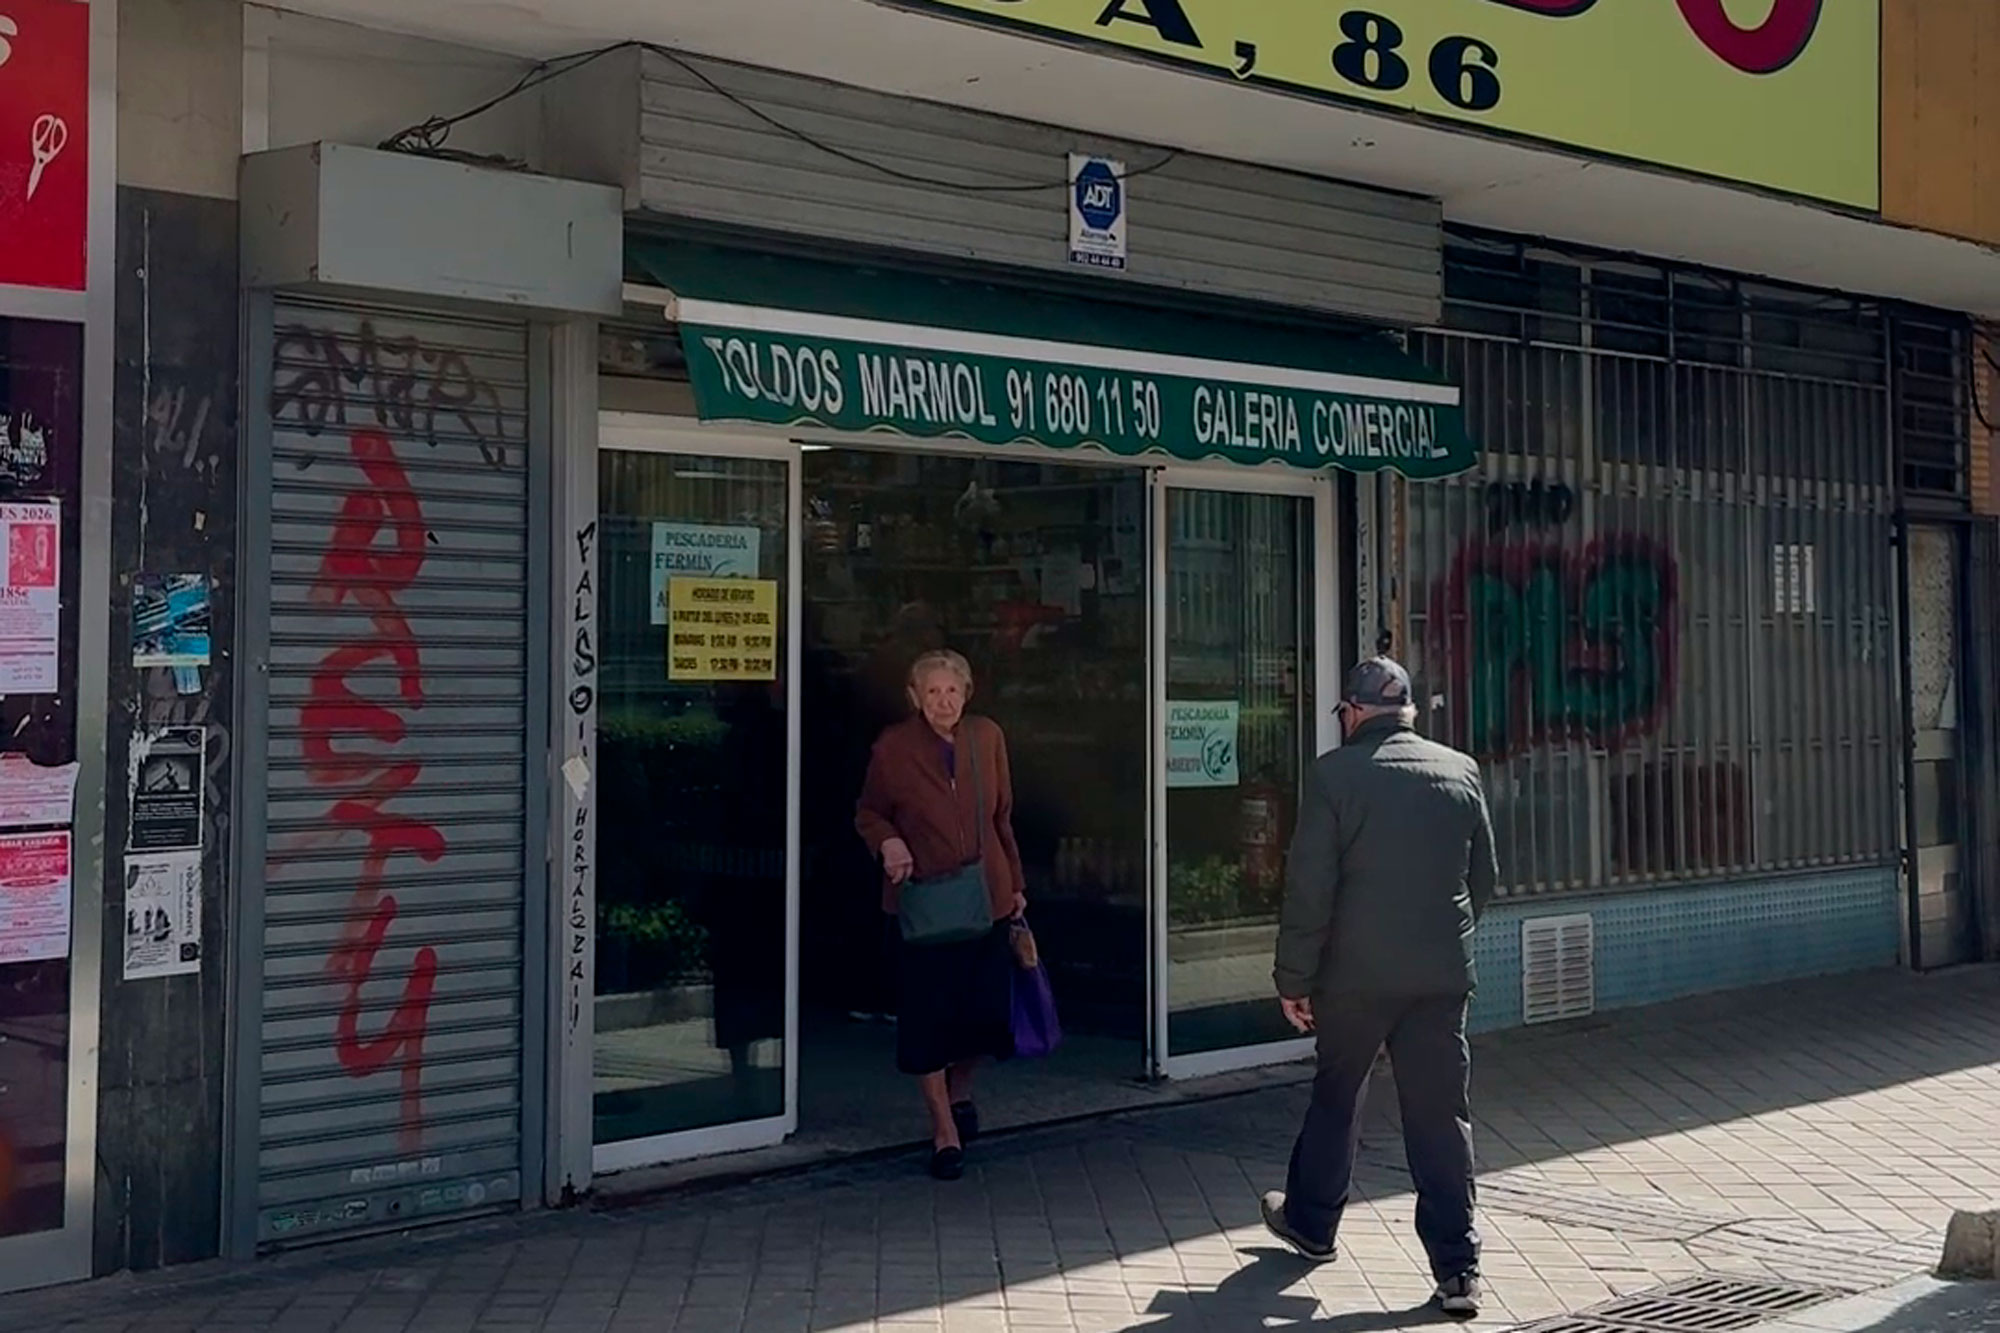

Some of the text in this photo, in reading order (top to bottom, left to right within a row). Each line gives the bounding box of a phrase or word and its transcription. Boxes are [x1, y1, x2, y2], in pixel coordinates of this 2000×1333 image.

[1332, 10, 1502, 111] 86
[1083, 183, 1113, 209] ADT
[702, 336, 1449, 459] TOLDOS MARMOL 91 680 11 50 GALERIA COMERCIAL
[21, 506, 53, 521] 2026
[655, 551, 713, 571] FERMÍN
